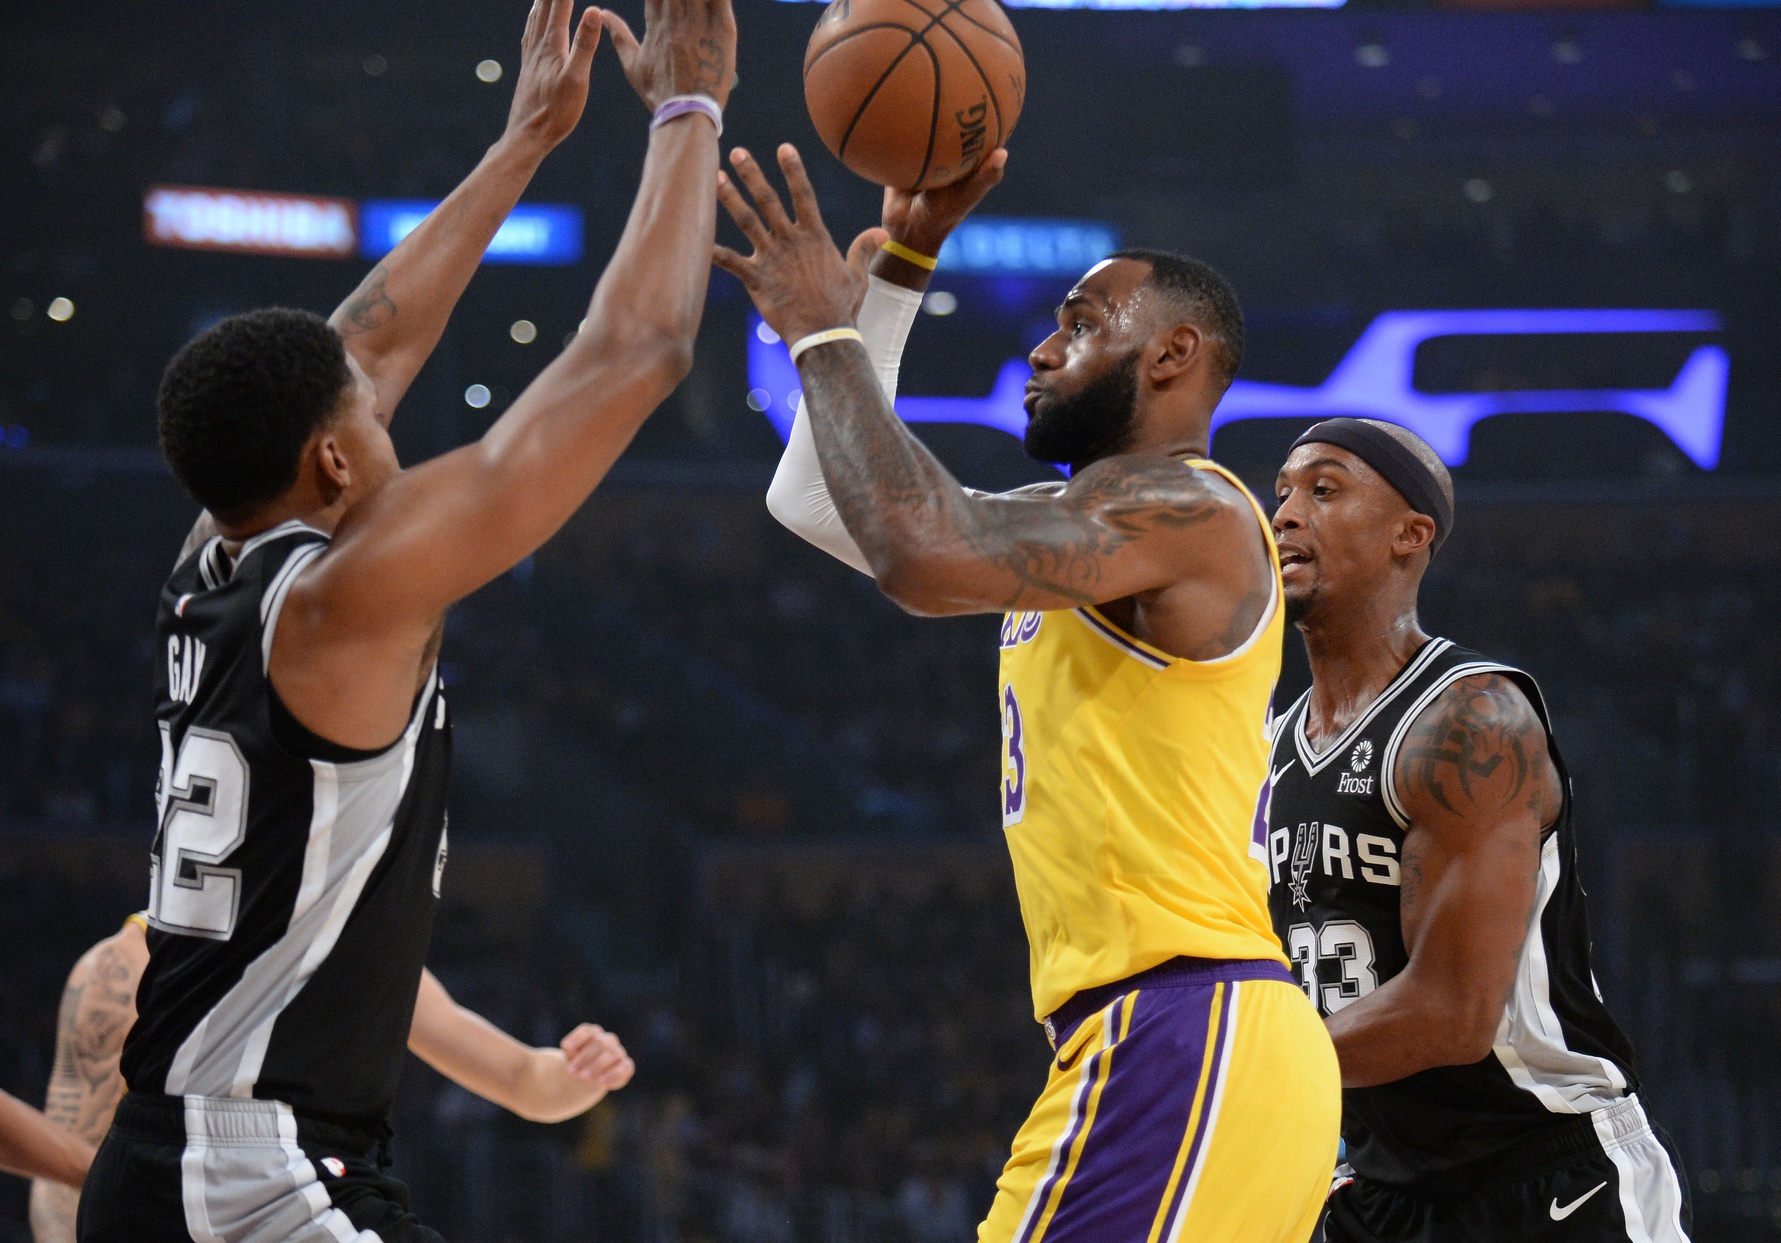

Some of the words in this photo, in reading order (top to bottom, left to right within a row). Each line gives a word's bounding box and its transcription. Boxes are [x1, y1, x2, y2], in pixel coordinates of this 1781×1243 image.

[167, 634, 206, 706] GAY
[1336, 772, 1374, 795] Frost
[1269, 822, 1401, 912] PURS
[1288, 919, 1379, 1018] 33
